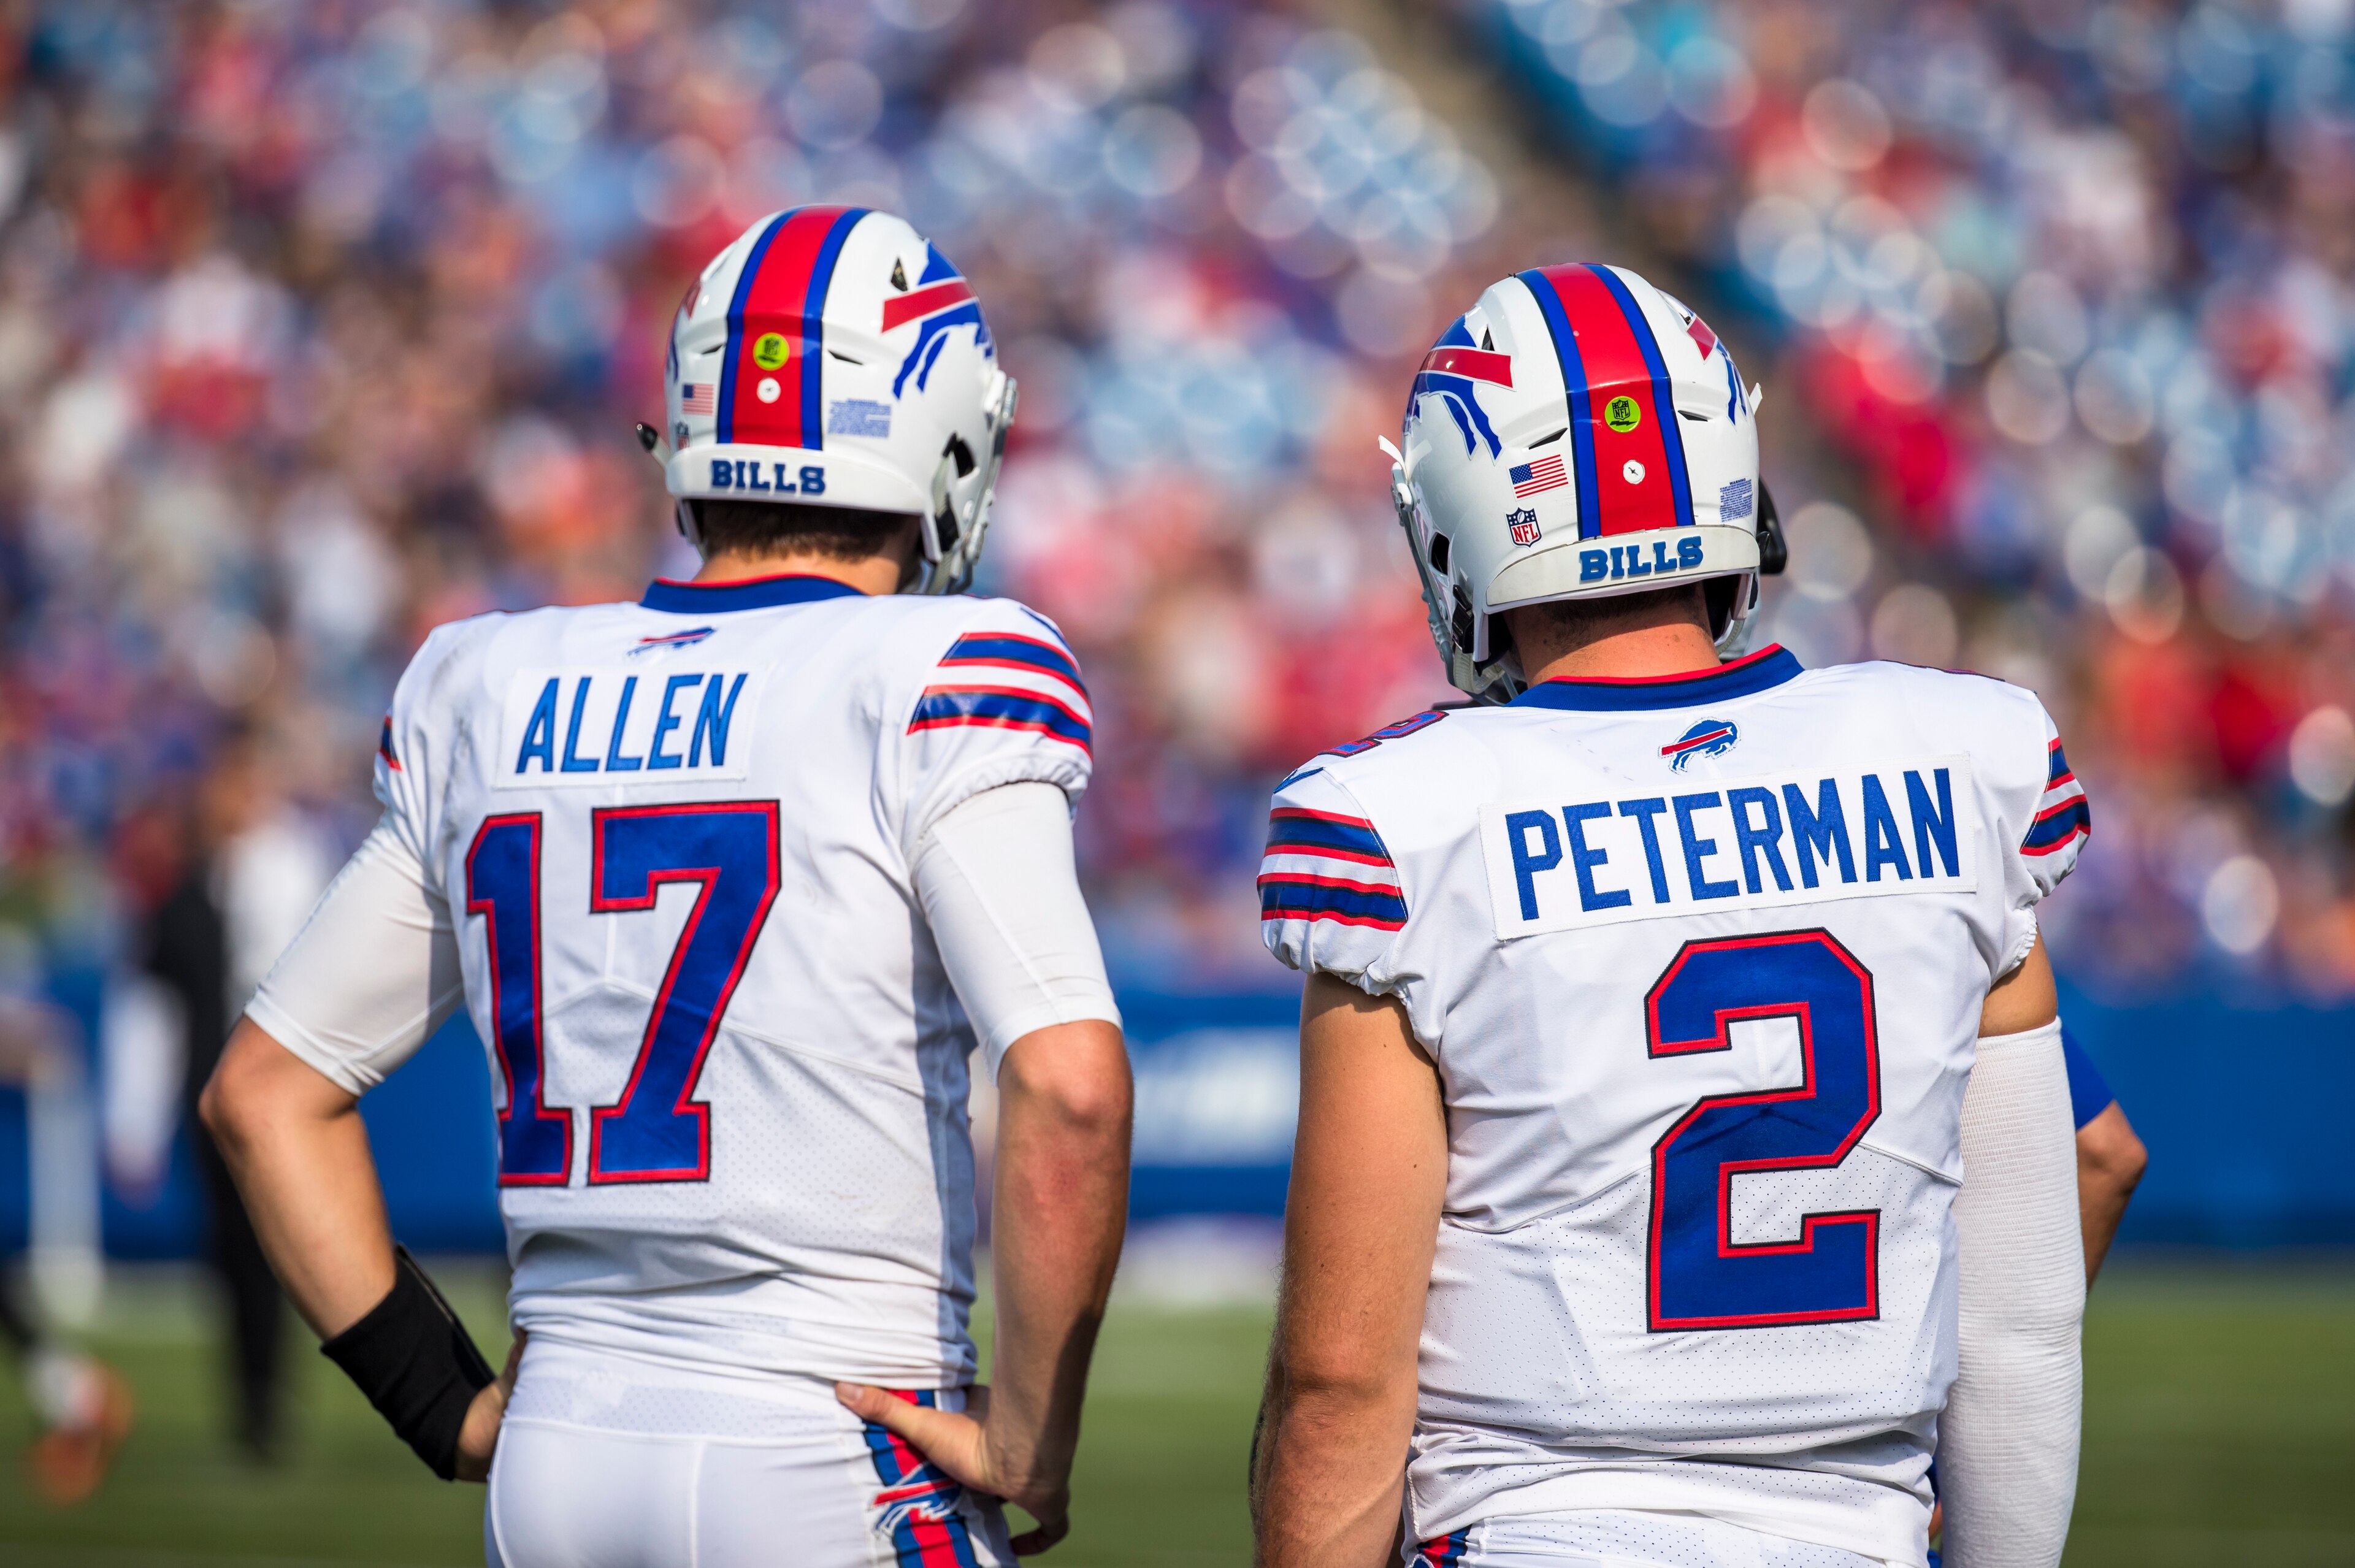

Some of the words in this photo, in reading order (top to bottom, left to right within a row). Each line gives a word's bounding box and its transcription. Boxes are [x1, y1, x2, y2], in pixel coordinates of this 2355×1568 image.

[1614, 408, 1629, 418] NFL
[711, 460, 826, 493] BILLS
[1512, 523, 1539, 543] NFL
[1579, 535, 1704, 581] BILLS
[515, 673, 749, 773] ALLEN
[1505, 768, 1961, 921] PETERMAN
[465, 800, 781, 1187] 17
[1644, 927, 1882, 1333] 2
